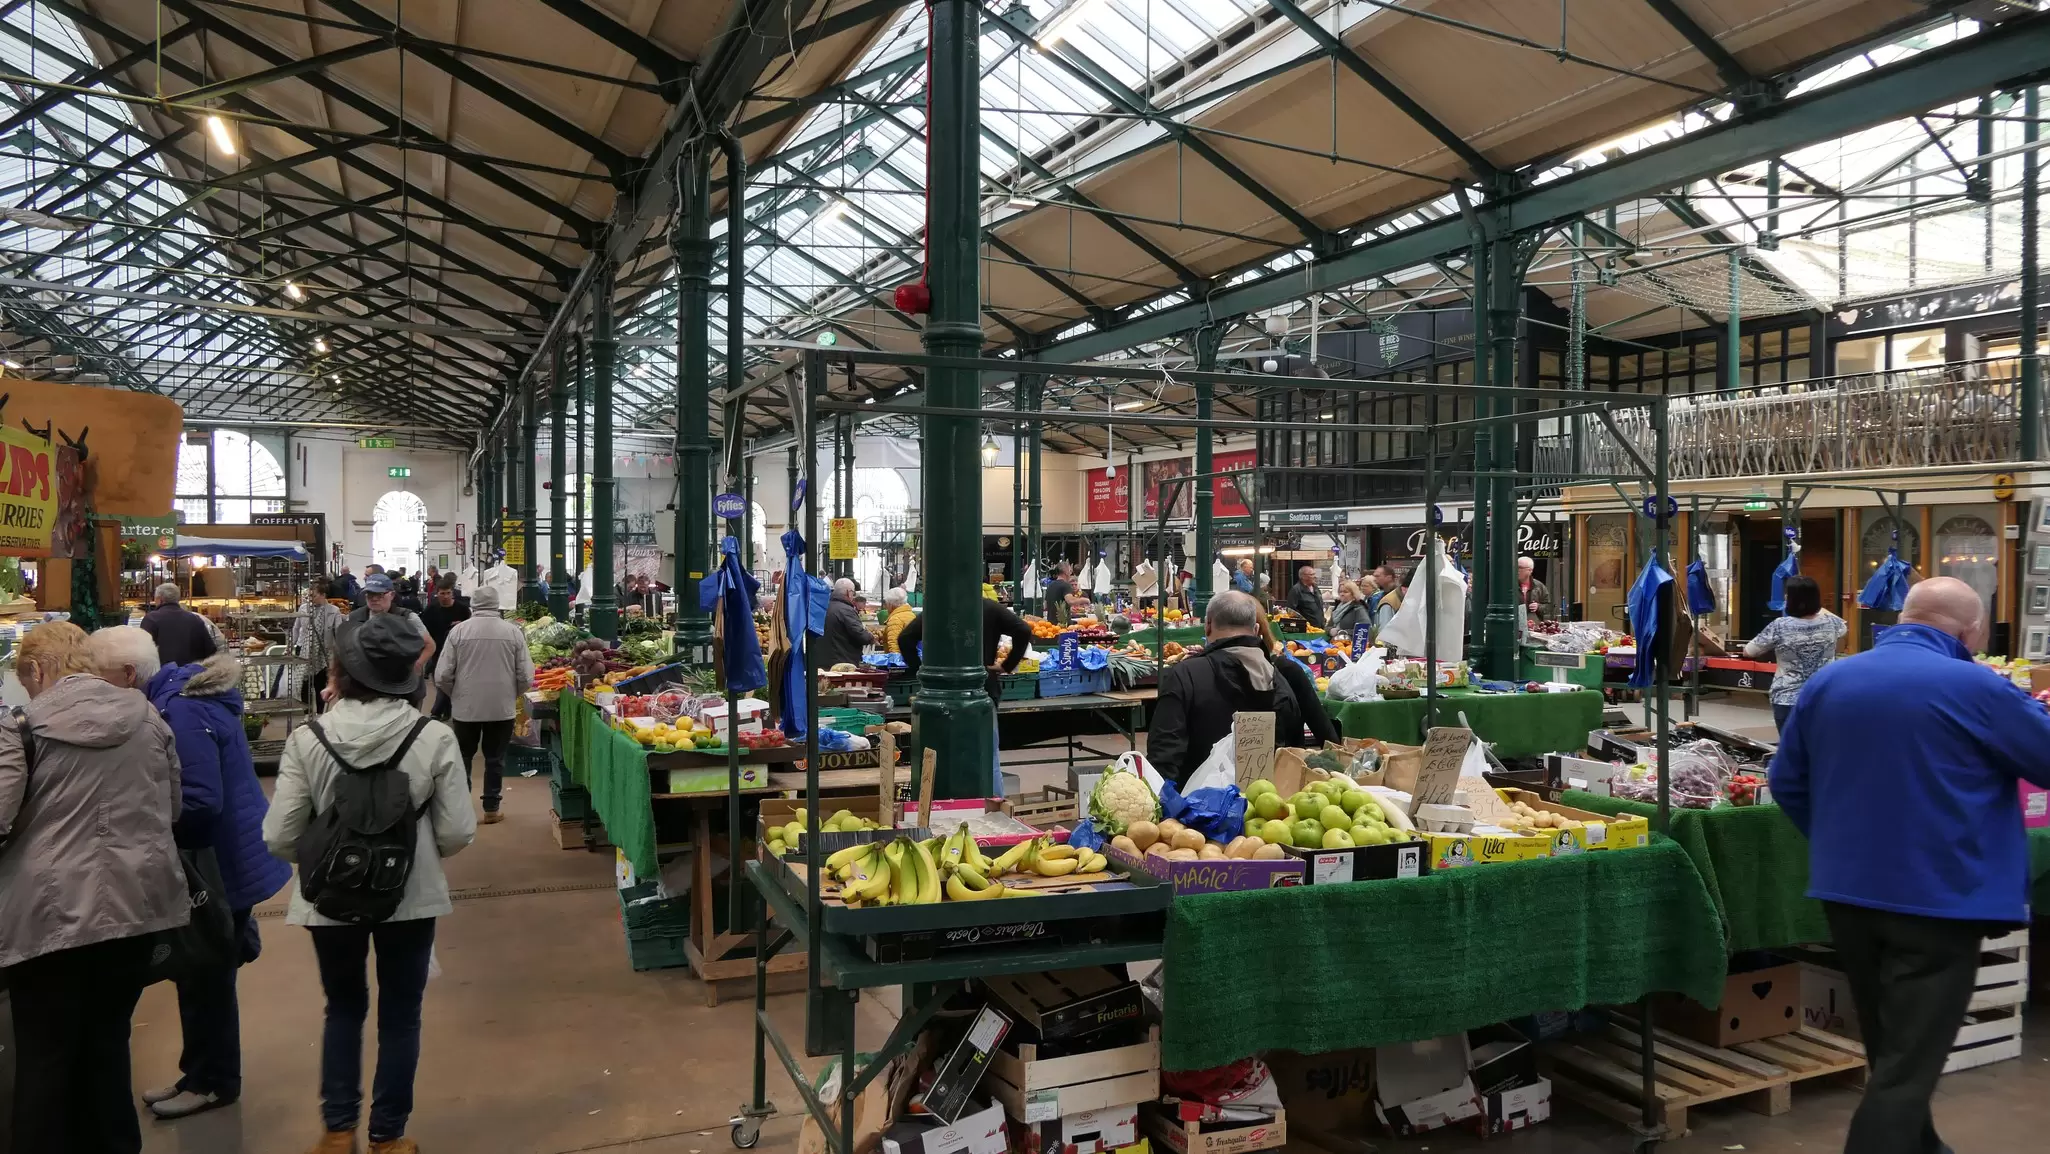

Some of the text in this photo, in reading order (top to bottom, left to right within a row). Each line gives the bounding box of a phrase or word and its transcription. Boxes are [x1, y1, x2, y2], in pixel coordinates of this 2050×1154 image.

[717, 499, 744, 513] Fyffes
[1289, 513, 1310, 521] Seating
[1060, 637, 1077, 665] Simply
[1482, 837, 1506, 859] Lila
[1173, 866, 1228, 893] MAGIC
[946, 926, 981, 943] Oeste
[1097, 1002, 1138, 1024] Frutaria
